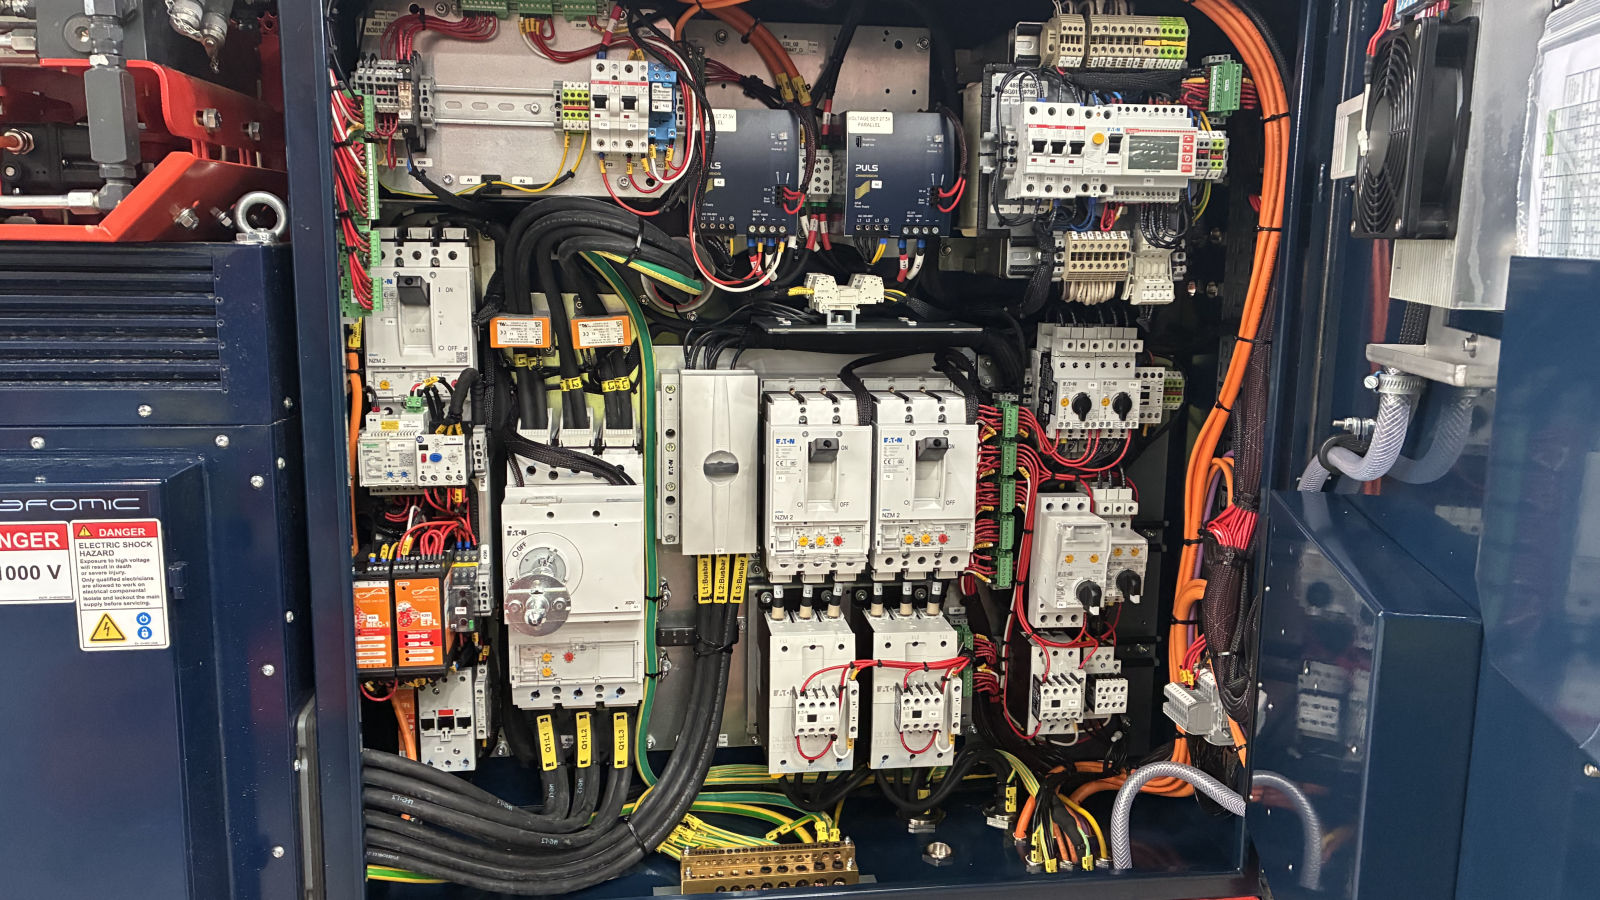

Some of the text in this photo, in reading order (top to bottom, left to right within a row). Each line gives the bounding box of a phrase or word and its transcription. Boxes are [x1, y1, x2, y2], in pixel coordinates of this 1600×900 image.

[98, 528, 146, 537] DANGER
[47, 565, 61, 579] V
[735, 560, 745, 594] L3:Busbar
